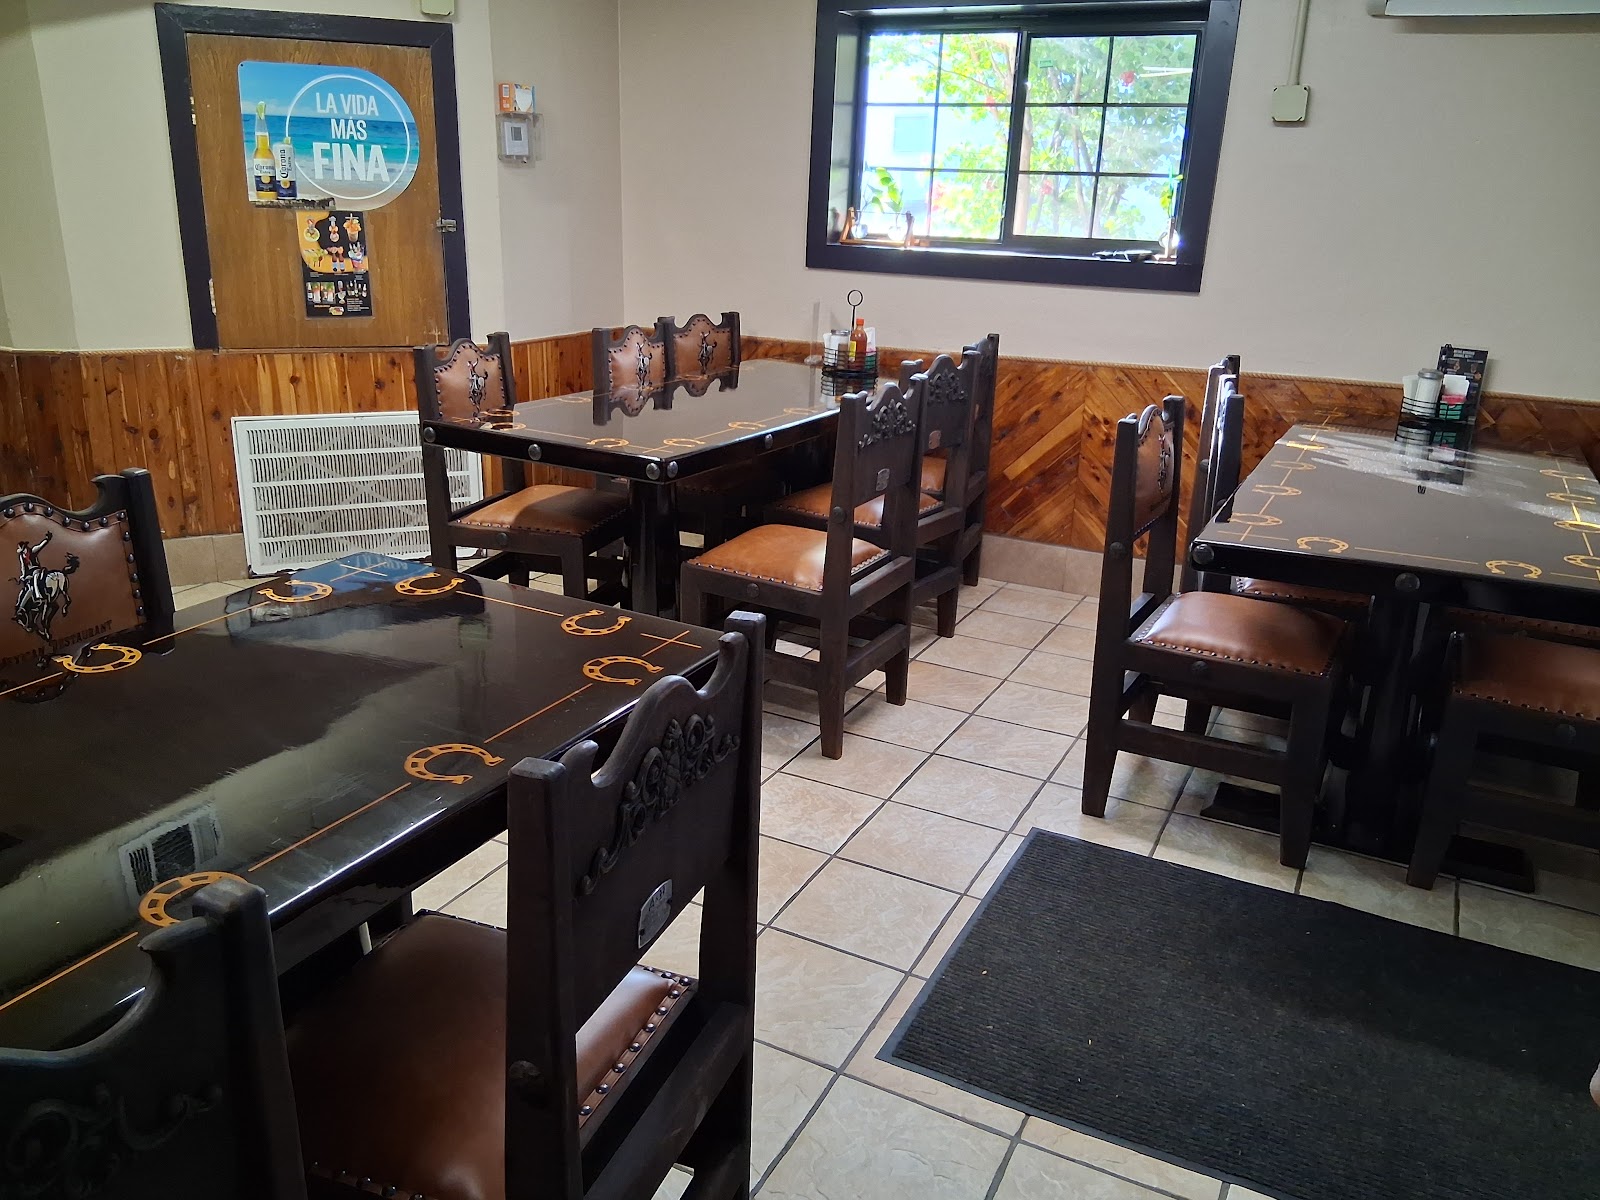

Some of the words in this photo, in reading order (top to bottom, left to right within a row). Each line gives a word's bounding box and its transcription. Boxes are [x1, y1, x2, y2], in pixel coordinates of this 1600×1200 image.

[315, 92, 338, 114] LA
[340, 93, 379, 116] VIDA
[330, 116, 367, 141] MÁS
[255, 163, 275, 171] Corona
[280, 149, 288, 178] Corona
[312, 142, 390, 182] FINA
